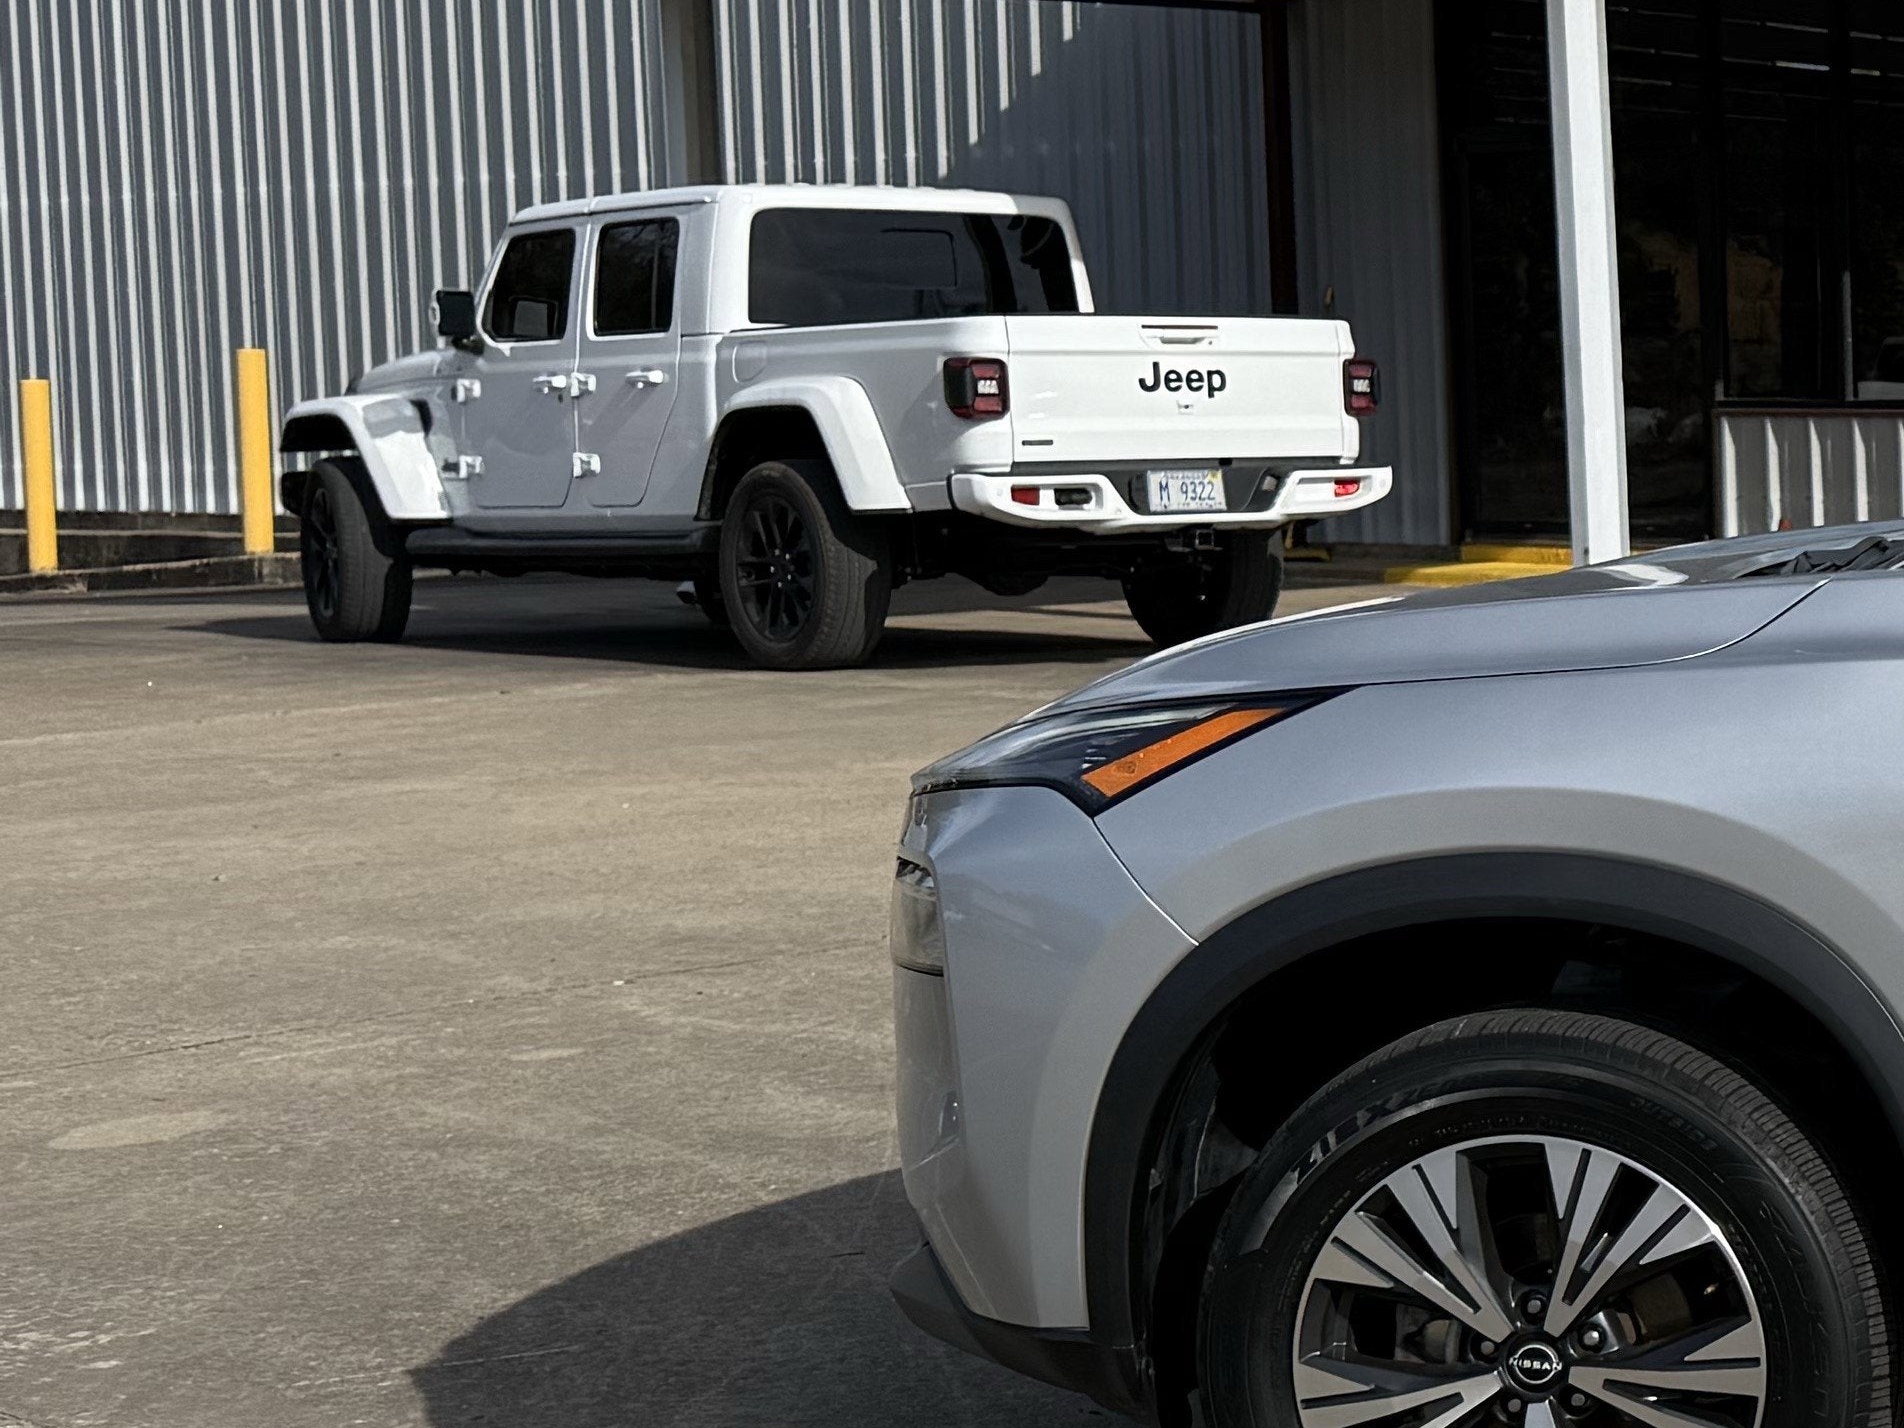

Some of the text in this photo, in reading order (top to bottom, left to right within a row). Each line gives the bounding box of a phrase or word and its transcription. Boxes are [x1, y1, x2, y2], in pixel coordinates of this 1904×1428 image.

[1138, 361, 1227, 398] Jeep
[1180, 480, 1216, 503] 9322
[1508, 1354, 1563, 1371] NISSAN
